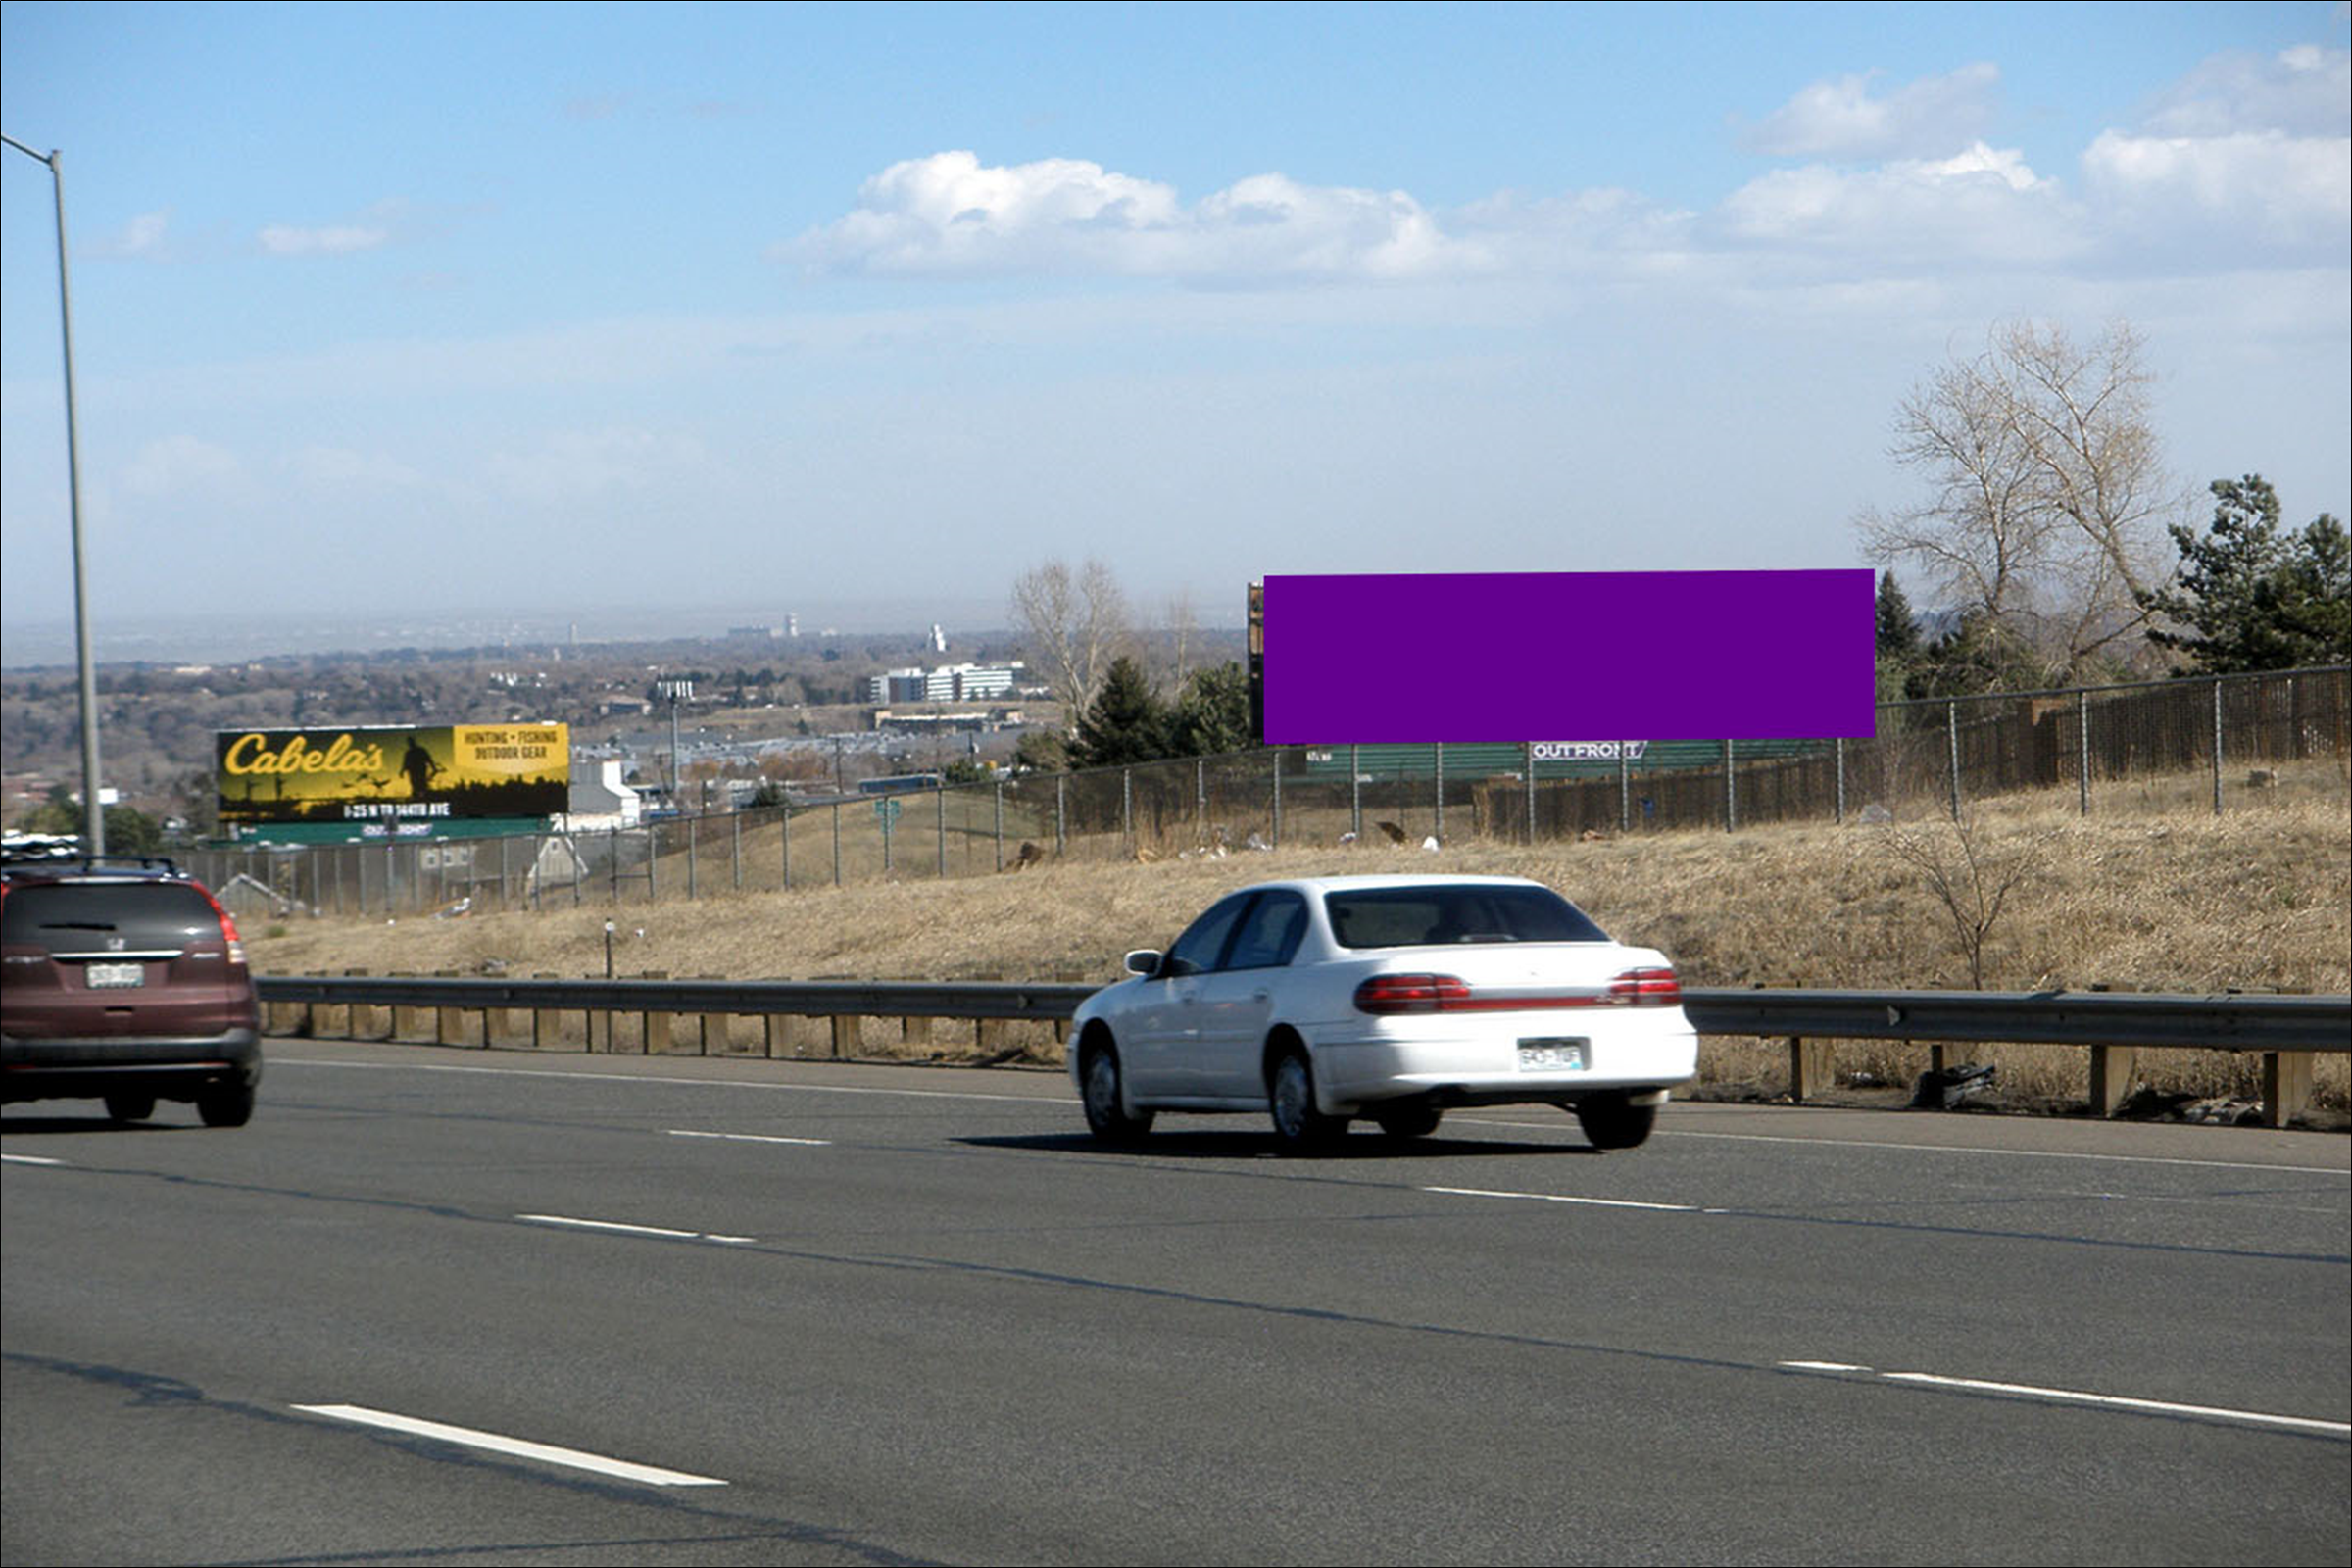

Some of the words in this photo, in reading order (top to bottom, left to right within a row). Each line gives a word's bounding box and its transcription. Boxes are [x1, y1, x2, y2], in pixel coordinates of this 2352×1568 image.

[465, 731, 507, 744] HUNTING
[517, 730, 557, 744] FISHING
[224, 733, 383, 774] Cabela's
[474, 746, 518, 760] OUTDOOR
[521, 746, 547, 759] GEAR
[1533, 743, 1637, 758] OUTFRONT
[429, 802, 450, 815] AVE
